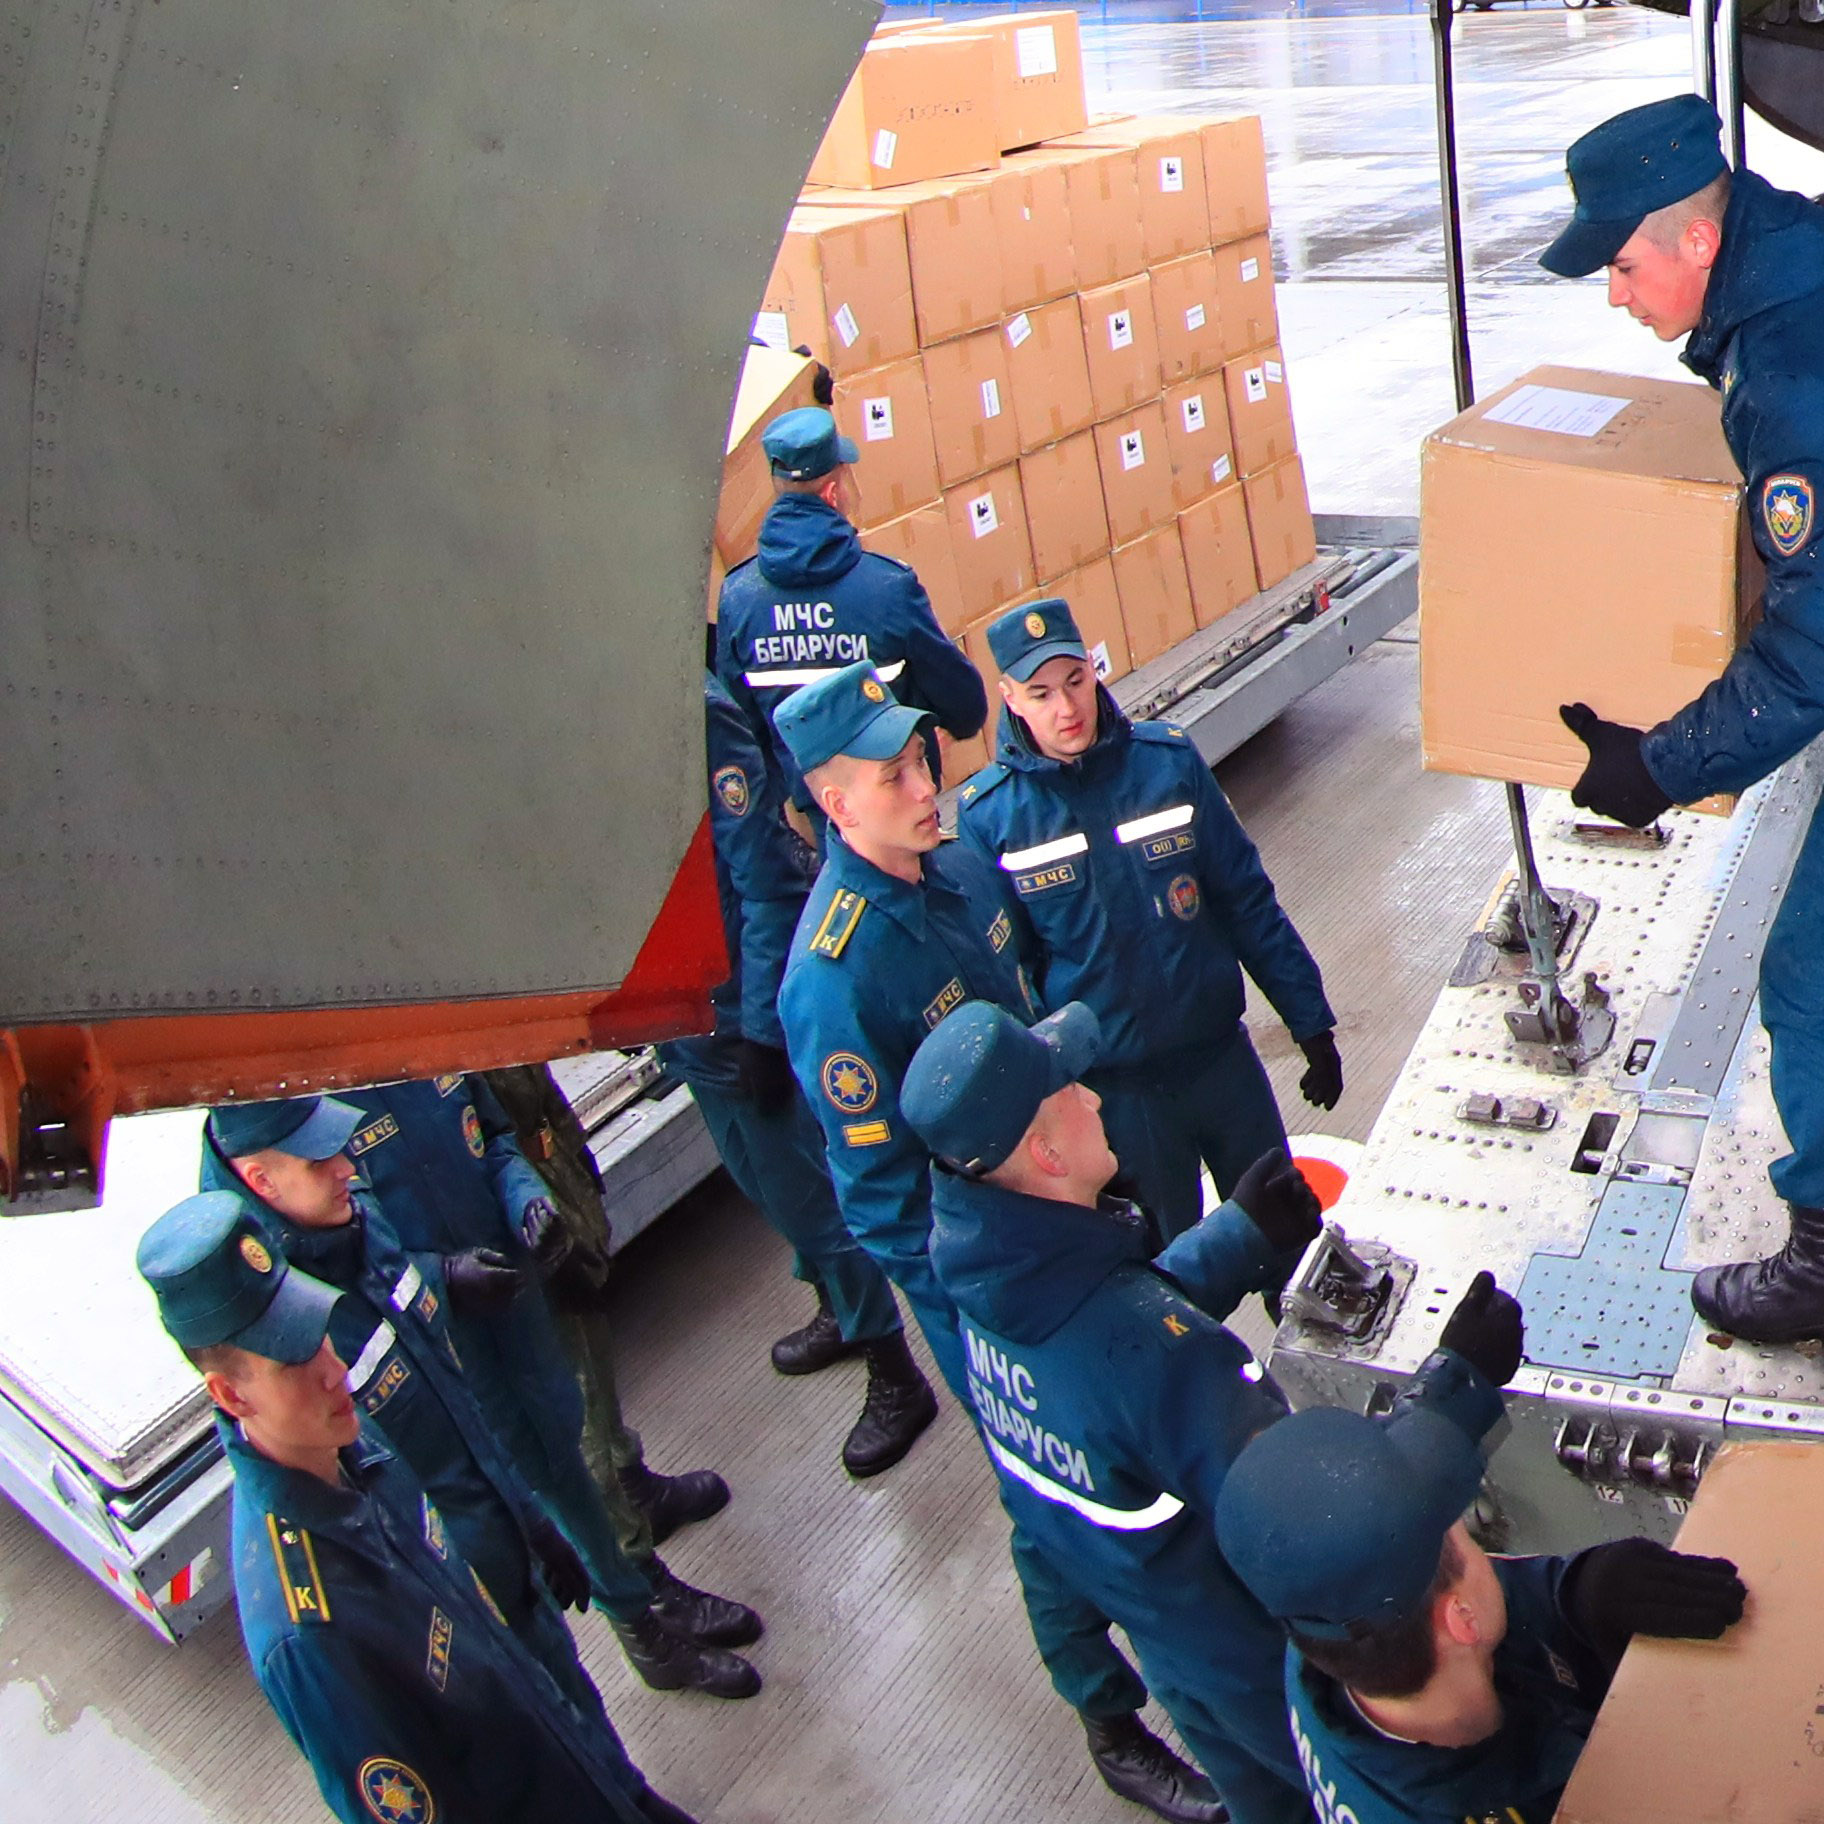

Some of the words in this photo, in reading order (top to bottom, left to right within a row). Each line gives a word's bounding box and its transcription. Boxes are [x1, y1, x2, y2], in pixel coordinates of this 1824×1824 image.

[774, 602, 835, 631] МЧС
[754, 634, 869, 664] БЕЛАРУСИ
[1035, 869, 1069, 886] МЧС
[819, 935, 837, 950] К
[1163, 1314, 1190, 1337] К
[967, 1328, 1037, 1411] МЧС
[294, 1586, 318, 1609] К
